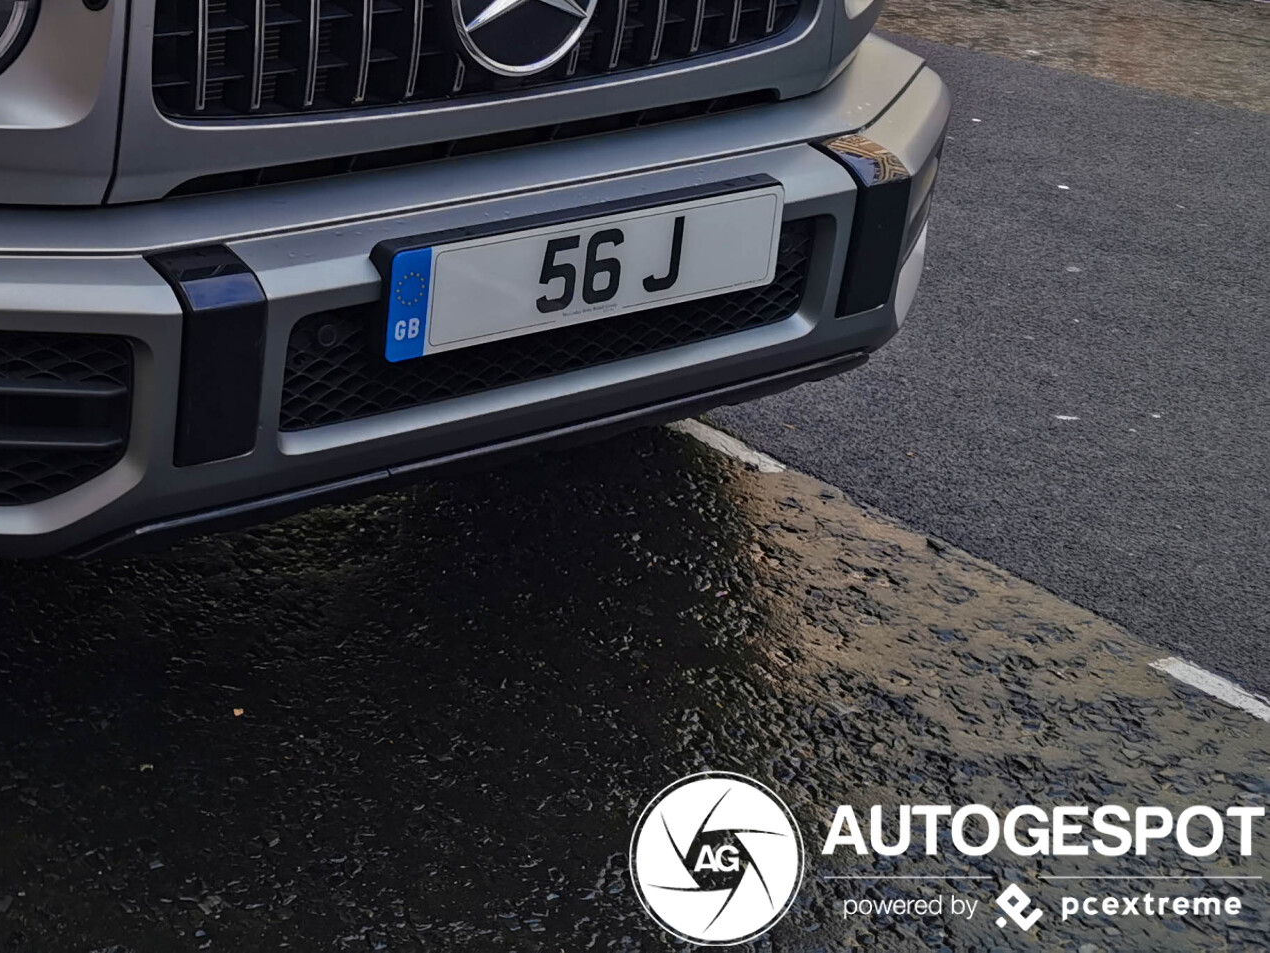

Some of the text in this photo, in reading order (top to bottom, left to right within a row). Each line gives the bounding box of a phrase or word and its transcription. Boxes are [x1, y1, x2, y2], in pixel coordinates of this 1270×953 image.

[536, 216, 685, 313] 56 J
[395, 318, 420, 341] GB
